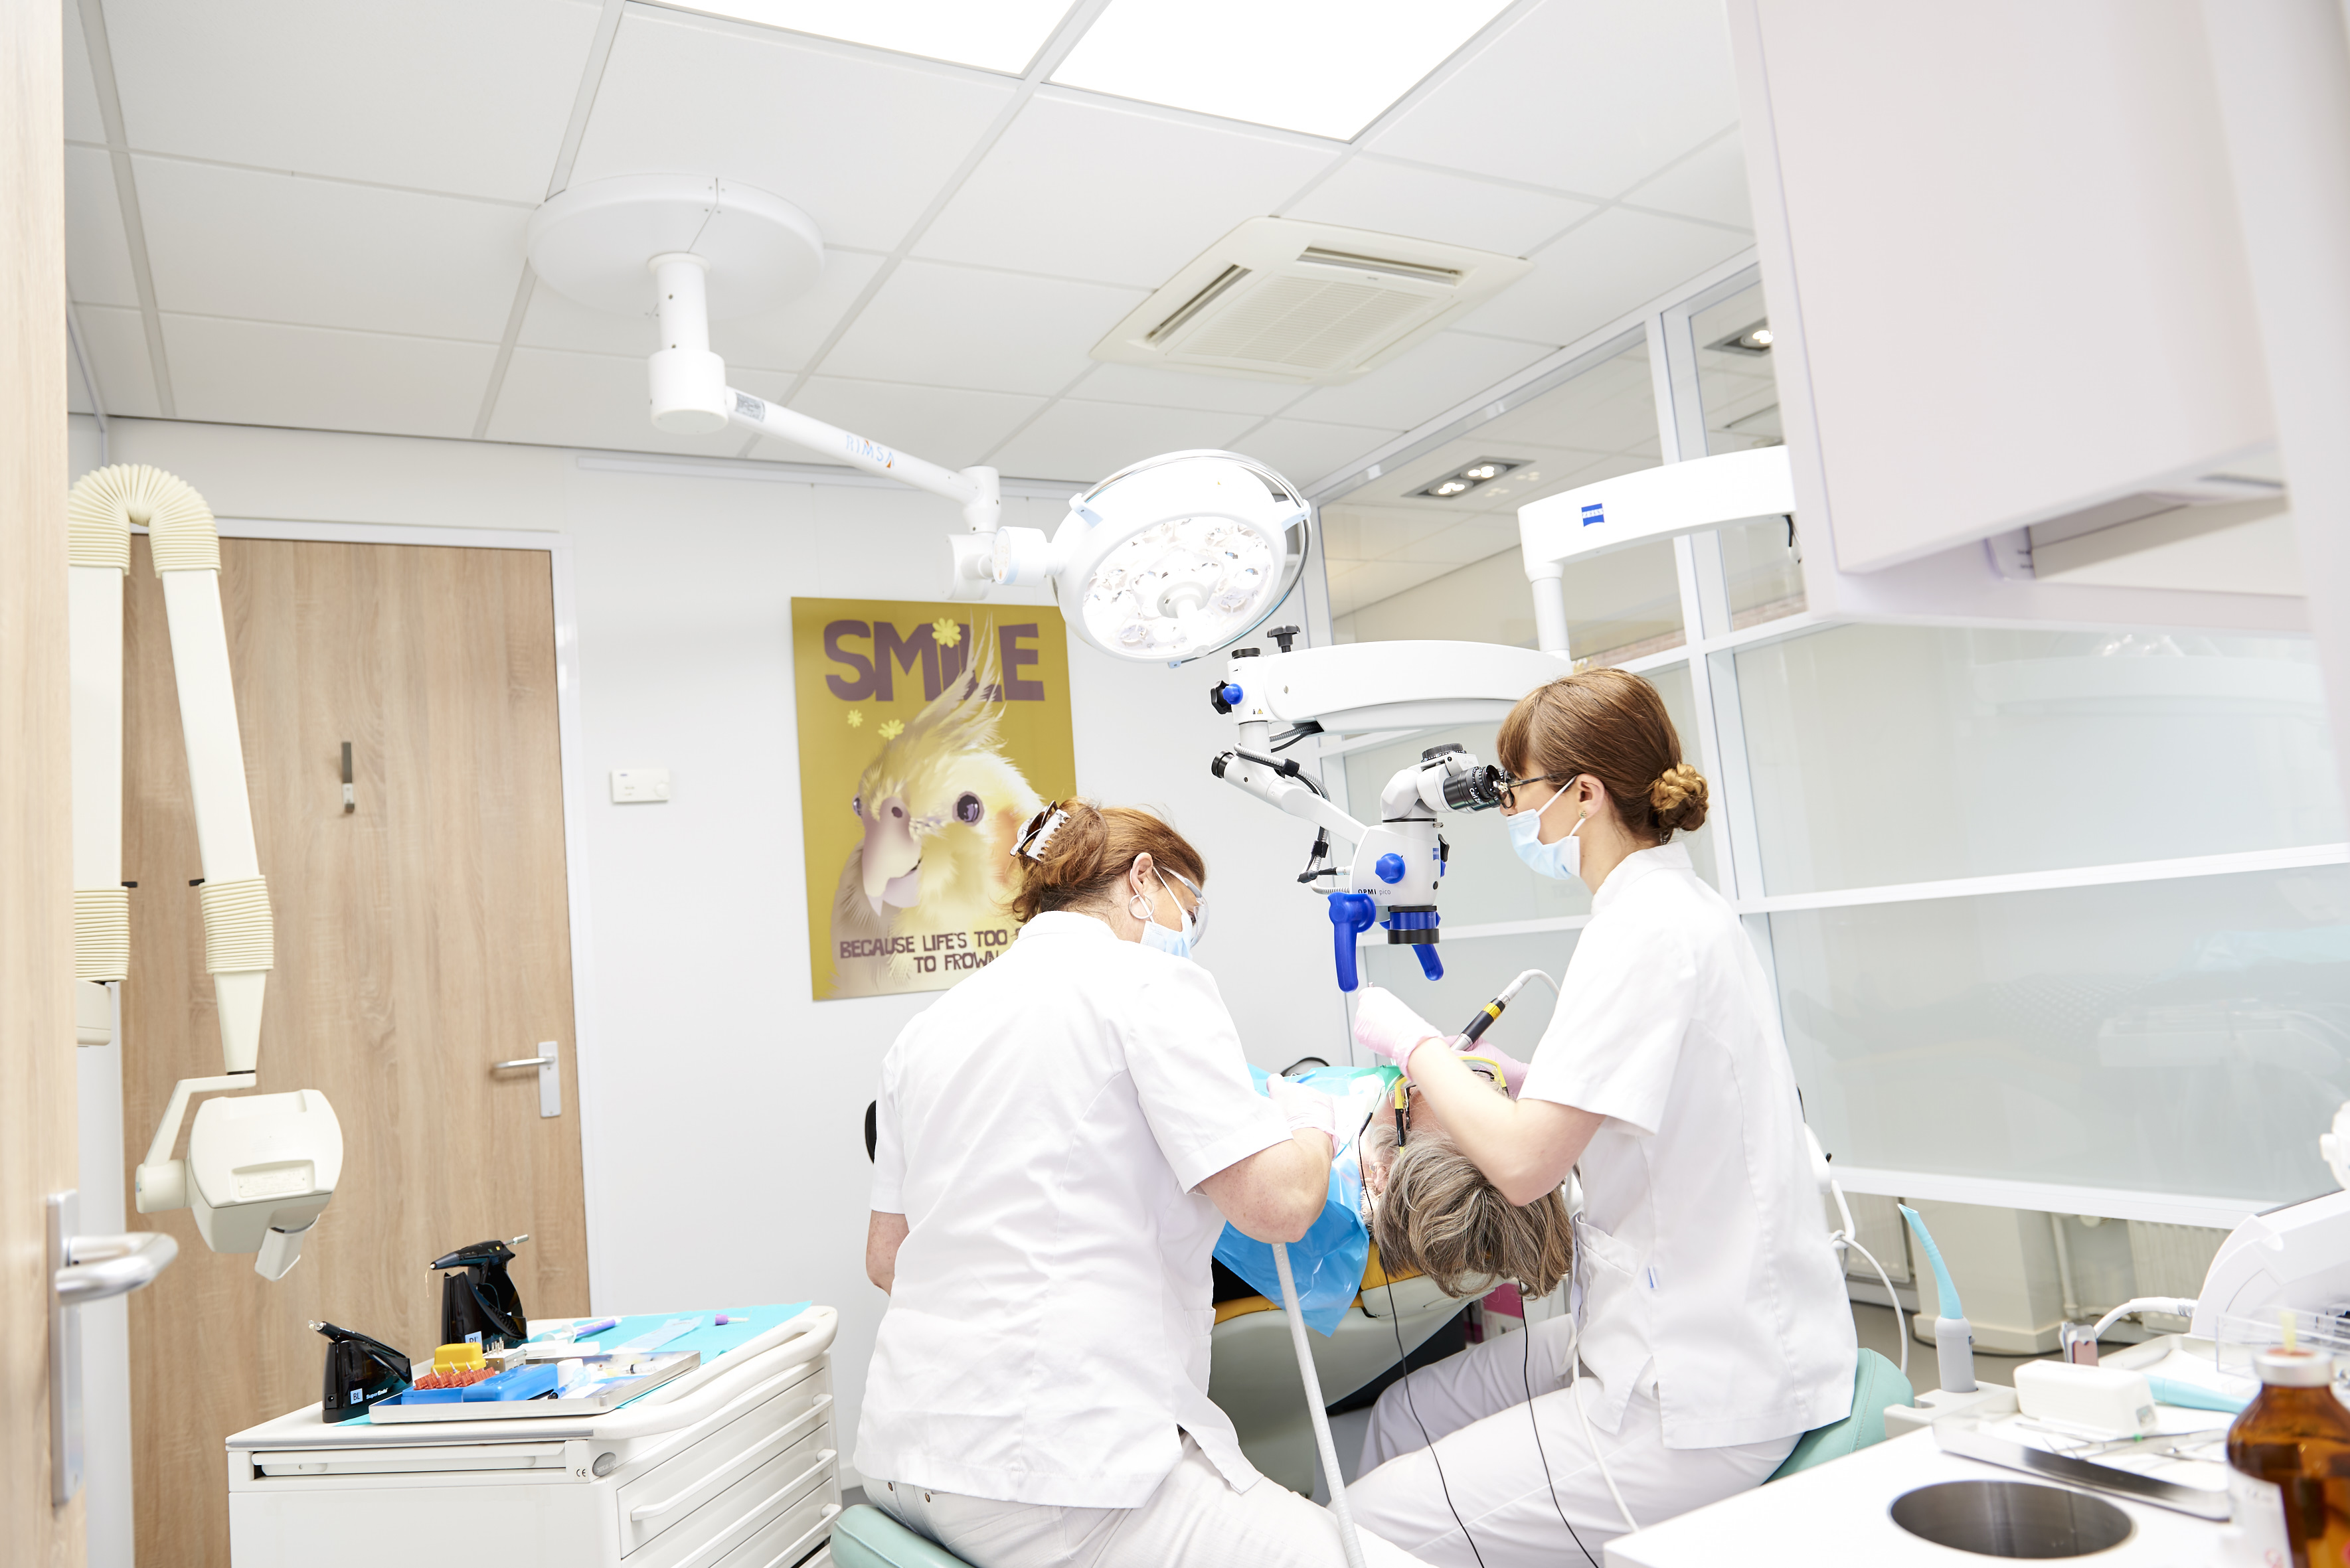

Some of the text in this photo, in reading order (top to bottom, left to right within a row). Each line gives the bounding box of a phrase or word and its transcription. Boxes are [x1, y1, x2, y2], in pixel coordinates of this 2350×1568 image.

[846, 435, 895, 469] RIMSA
[823, 619, 1045, 702] SMILE
[1469, 787, 1478, 798] Carl
[840, 936, 915, 959] BECAUSE
[923, 932, 967, 951] LIFE'S
[974, 929, 1008, 947] TOO
[913, 956, 936, 973] TO
